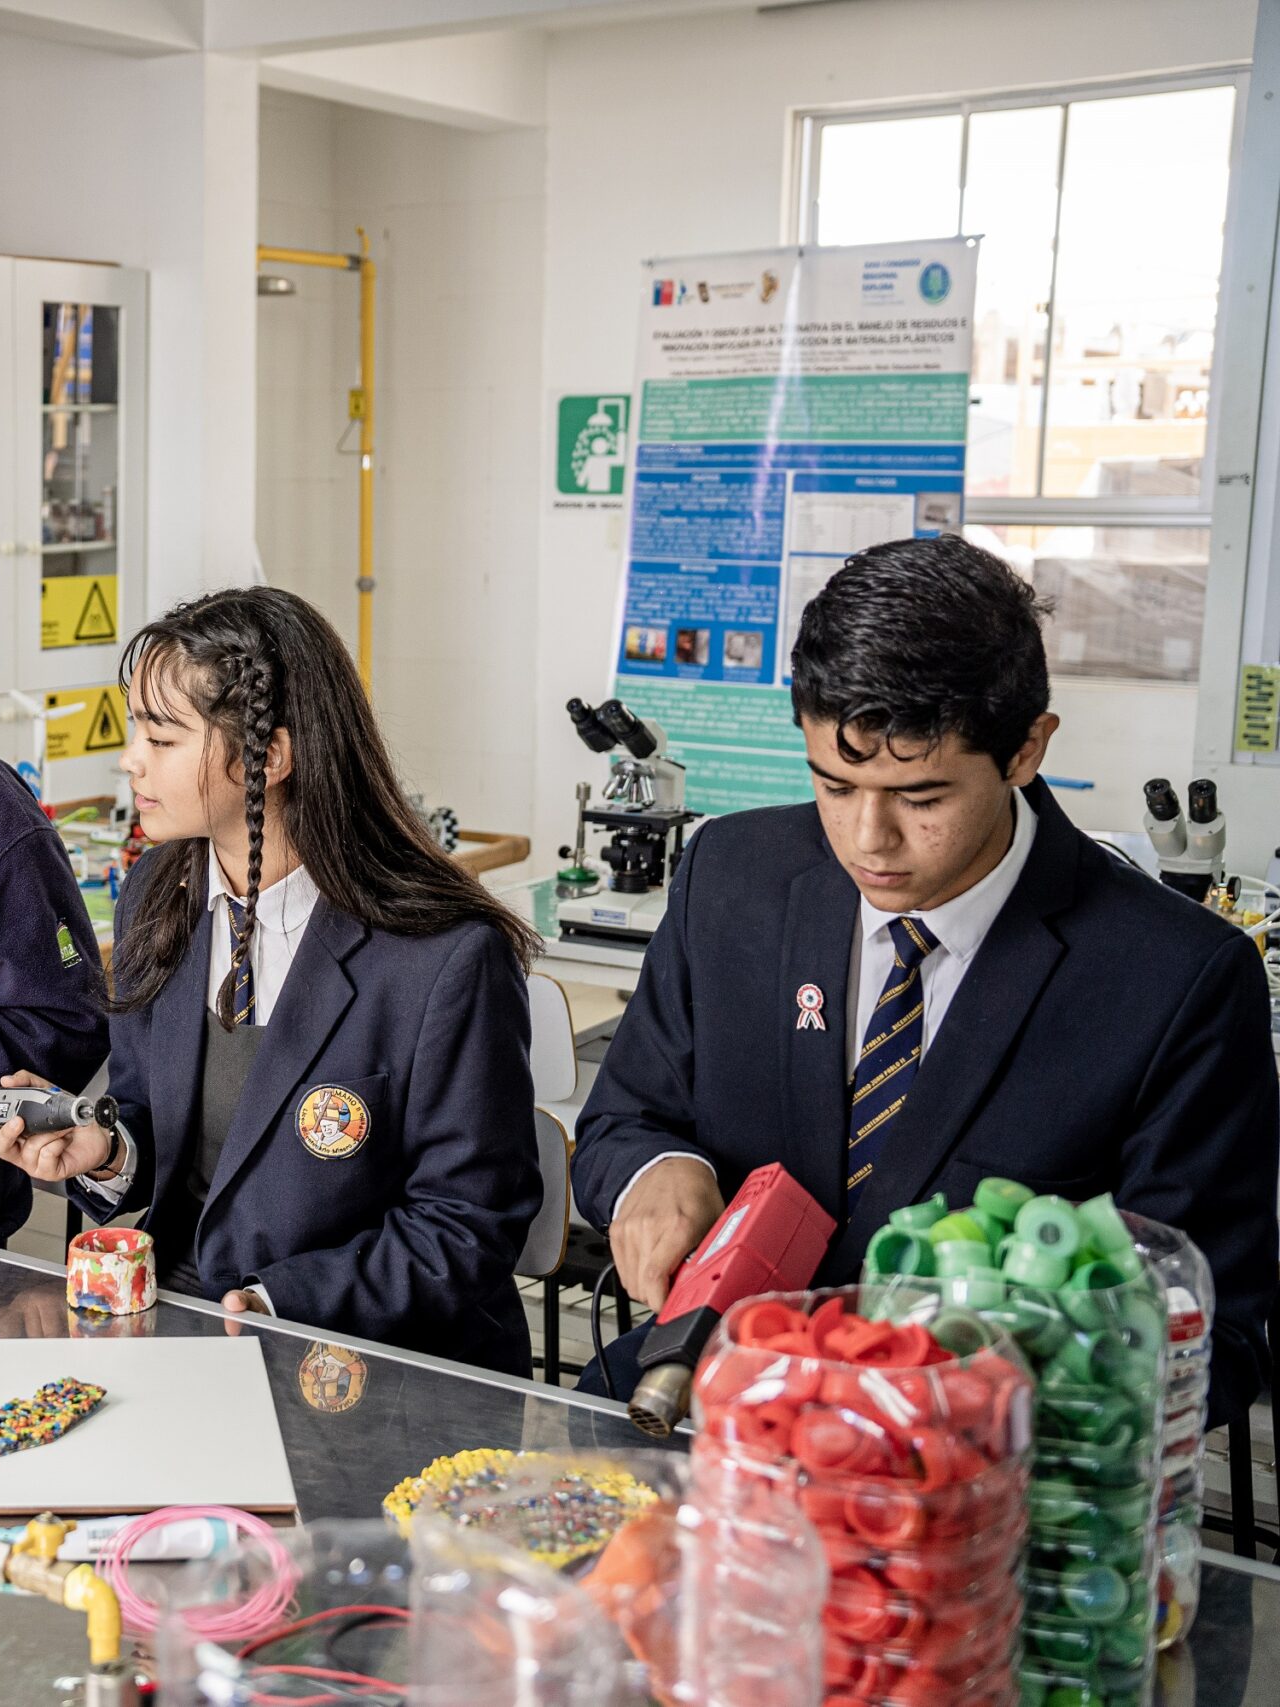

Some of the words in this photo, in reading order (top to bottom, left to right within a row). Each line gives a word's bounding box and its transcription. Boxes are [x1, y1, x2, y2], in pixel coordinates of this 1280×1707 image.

[857, 319, 893, 330] MANEJO
[910, 317, 957, 329] RESIDUOS
[845, 334, 900, 345] MATERIALES
[892, 1001, 924, 1030] BICENTENAR
[883, 1060, 901, 1076] PABLO
